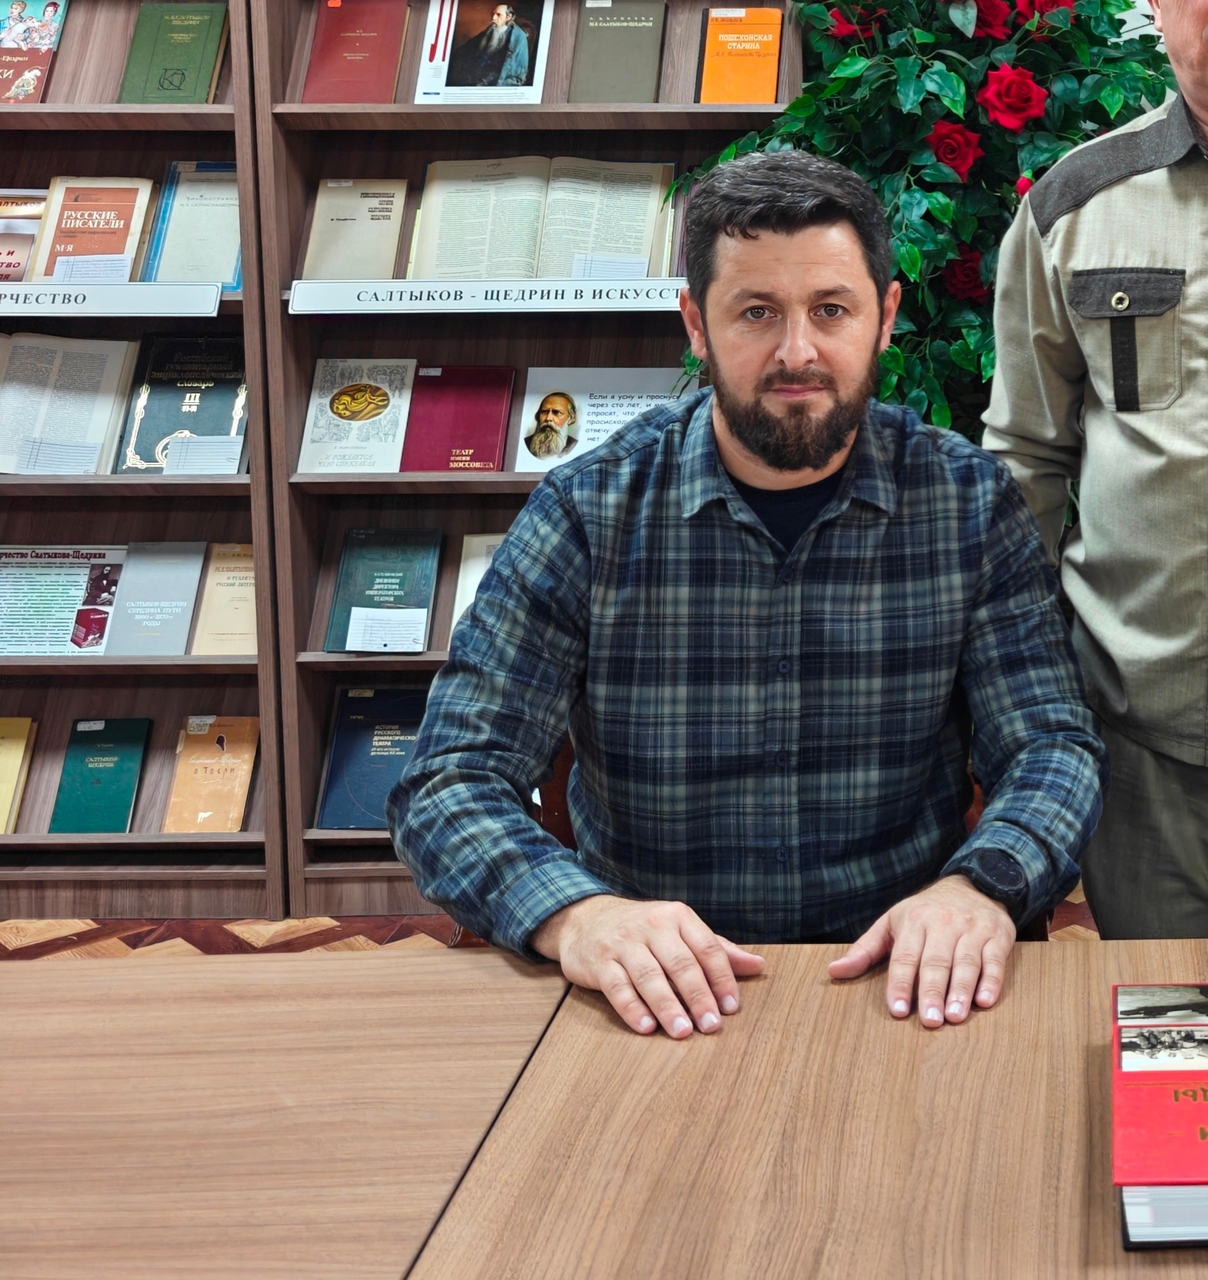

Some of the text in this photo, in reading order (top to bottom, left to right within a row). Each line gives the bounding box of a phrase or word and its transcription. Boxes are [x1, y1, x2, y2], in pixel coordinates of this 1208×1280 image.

[63, 210, 118, 220] РУССКИЕ
[61, 219, 125, 229] ПИСАТЕЛИ
[356, 290, 464, 302] САЛТЫКОВ
[483, 288, 565, 302] ЩЕДРИН
[574, 289, 584, 300] В
[617, 394, 635, 402] усну
[588, 403, 609, 412] через
[587, 411, 619, 419] спросят,
[30, 550, 106, 561] Салтыкова-Щедрина
